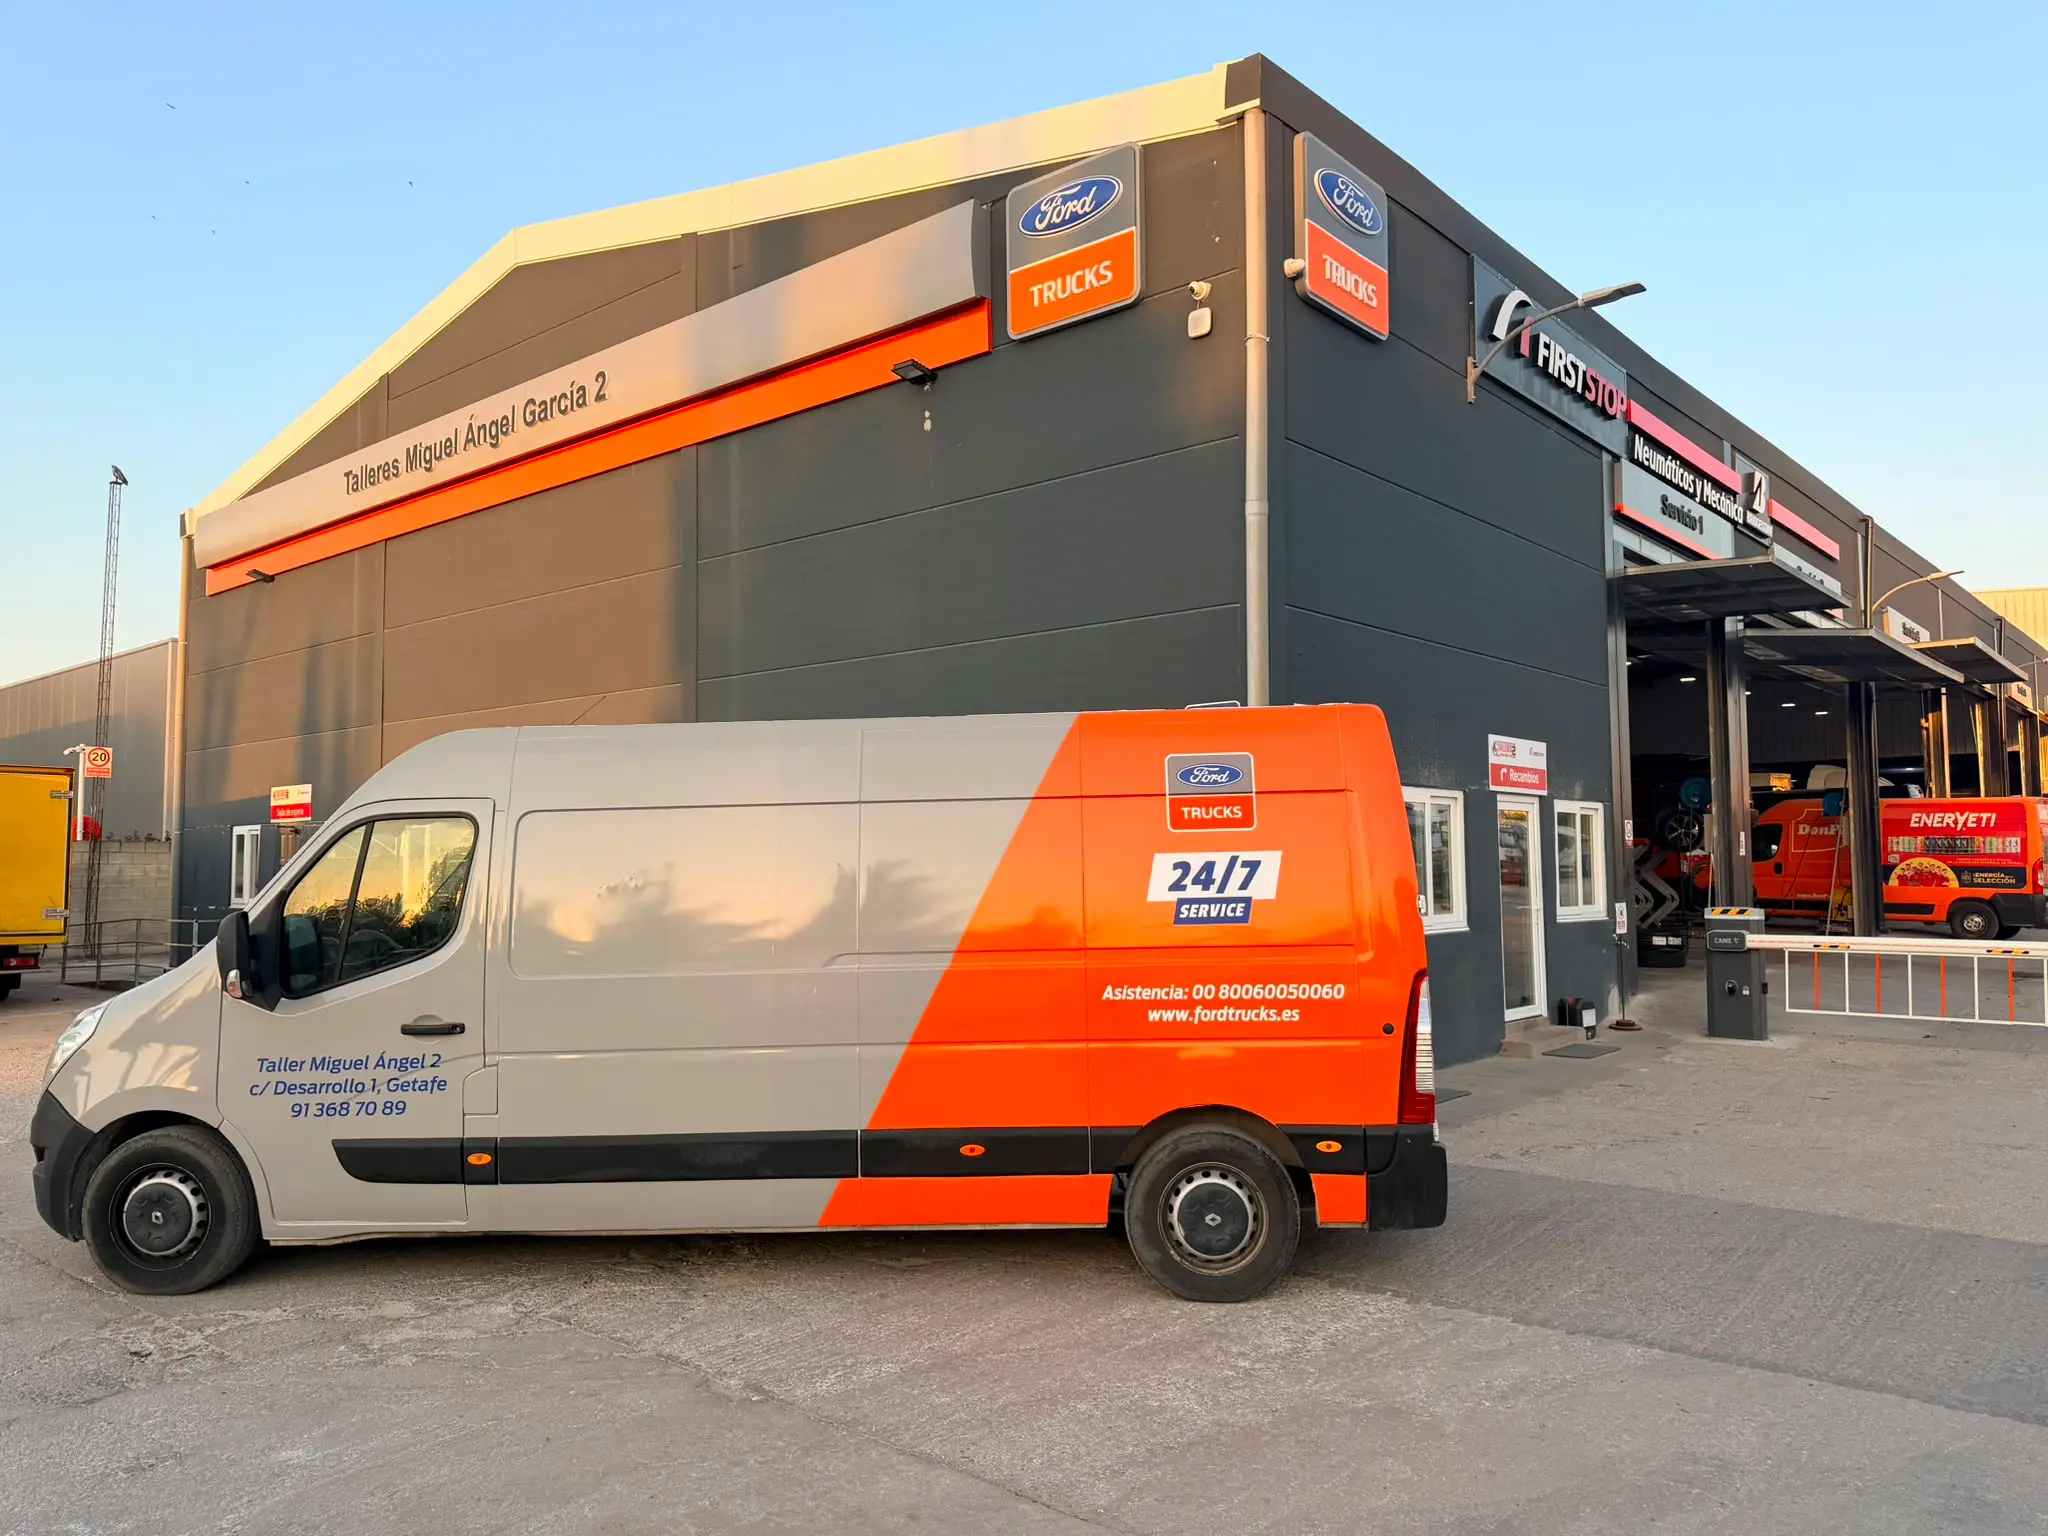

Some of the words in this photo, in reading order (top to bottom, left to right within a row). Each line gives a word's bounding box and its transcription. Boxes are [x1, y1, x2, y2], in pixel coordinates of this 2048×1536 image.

[1035, 185, 1097, 230] Ford
[1333, 177, 1373, 227] Ford
[1030, 260, 1113, 307] TRUCKS
[1322, 254, 1377, 308] TRUCKS
[344, 457, 400, 495] Talleres
[405, 428, 459, 473] Miguel
[463, 405, 516, 448] Ángel
[523, 381, 588, 427] García
[594, 371, 608, 402] 2
[1634, 434, 1694, 493] Neumáticos
[1695, 478, 1702, 502] y
[1703, 479, 1744, 524] Mecánica
[1660, 494, 1698, 531] Servicio
[1697, 515, 1704, 535] 1
[92, 752, 107, 761] 20
[1190, 767, 1230, 783] Ford
[1510, 768, 1539, 784] Recambios
[1181, 806, 1242, 819] TRUCKS
[1910, 811, 1997, 831] ENERYETI
[1168, 855, 1262, 894] 24/7
[1179, 903, 1246, 918] SERVICE
[1101, 985, 1189, 1000] Asistencia:
[1192, 984, 1216, 1000] 00
[1218, 983, 1345, 999] 80060050060
[1148, 1005, 1300, 1024] www.fordtrucks.es
[257, 1056, 306, 1073] Taller
[309, 1055, 370, 1074] Miguel
[373, 1051, 426, 1072] Ángel
[430, 1053, 442, 1068] 2
[250, 1081, 271, 1096] c/
[274, 1079, 366, 1096] Desarrollo
[370, 1079, 382, 1095] 1,
[386, 1075, 448, 1095] Getafe
[291, 1102, 310, 1118] 91
[313, 1101, 350, 1118] 368
[355, 1101, 377, 1116] 70
[382, 1100, 407, 1116] 89
